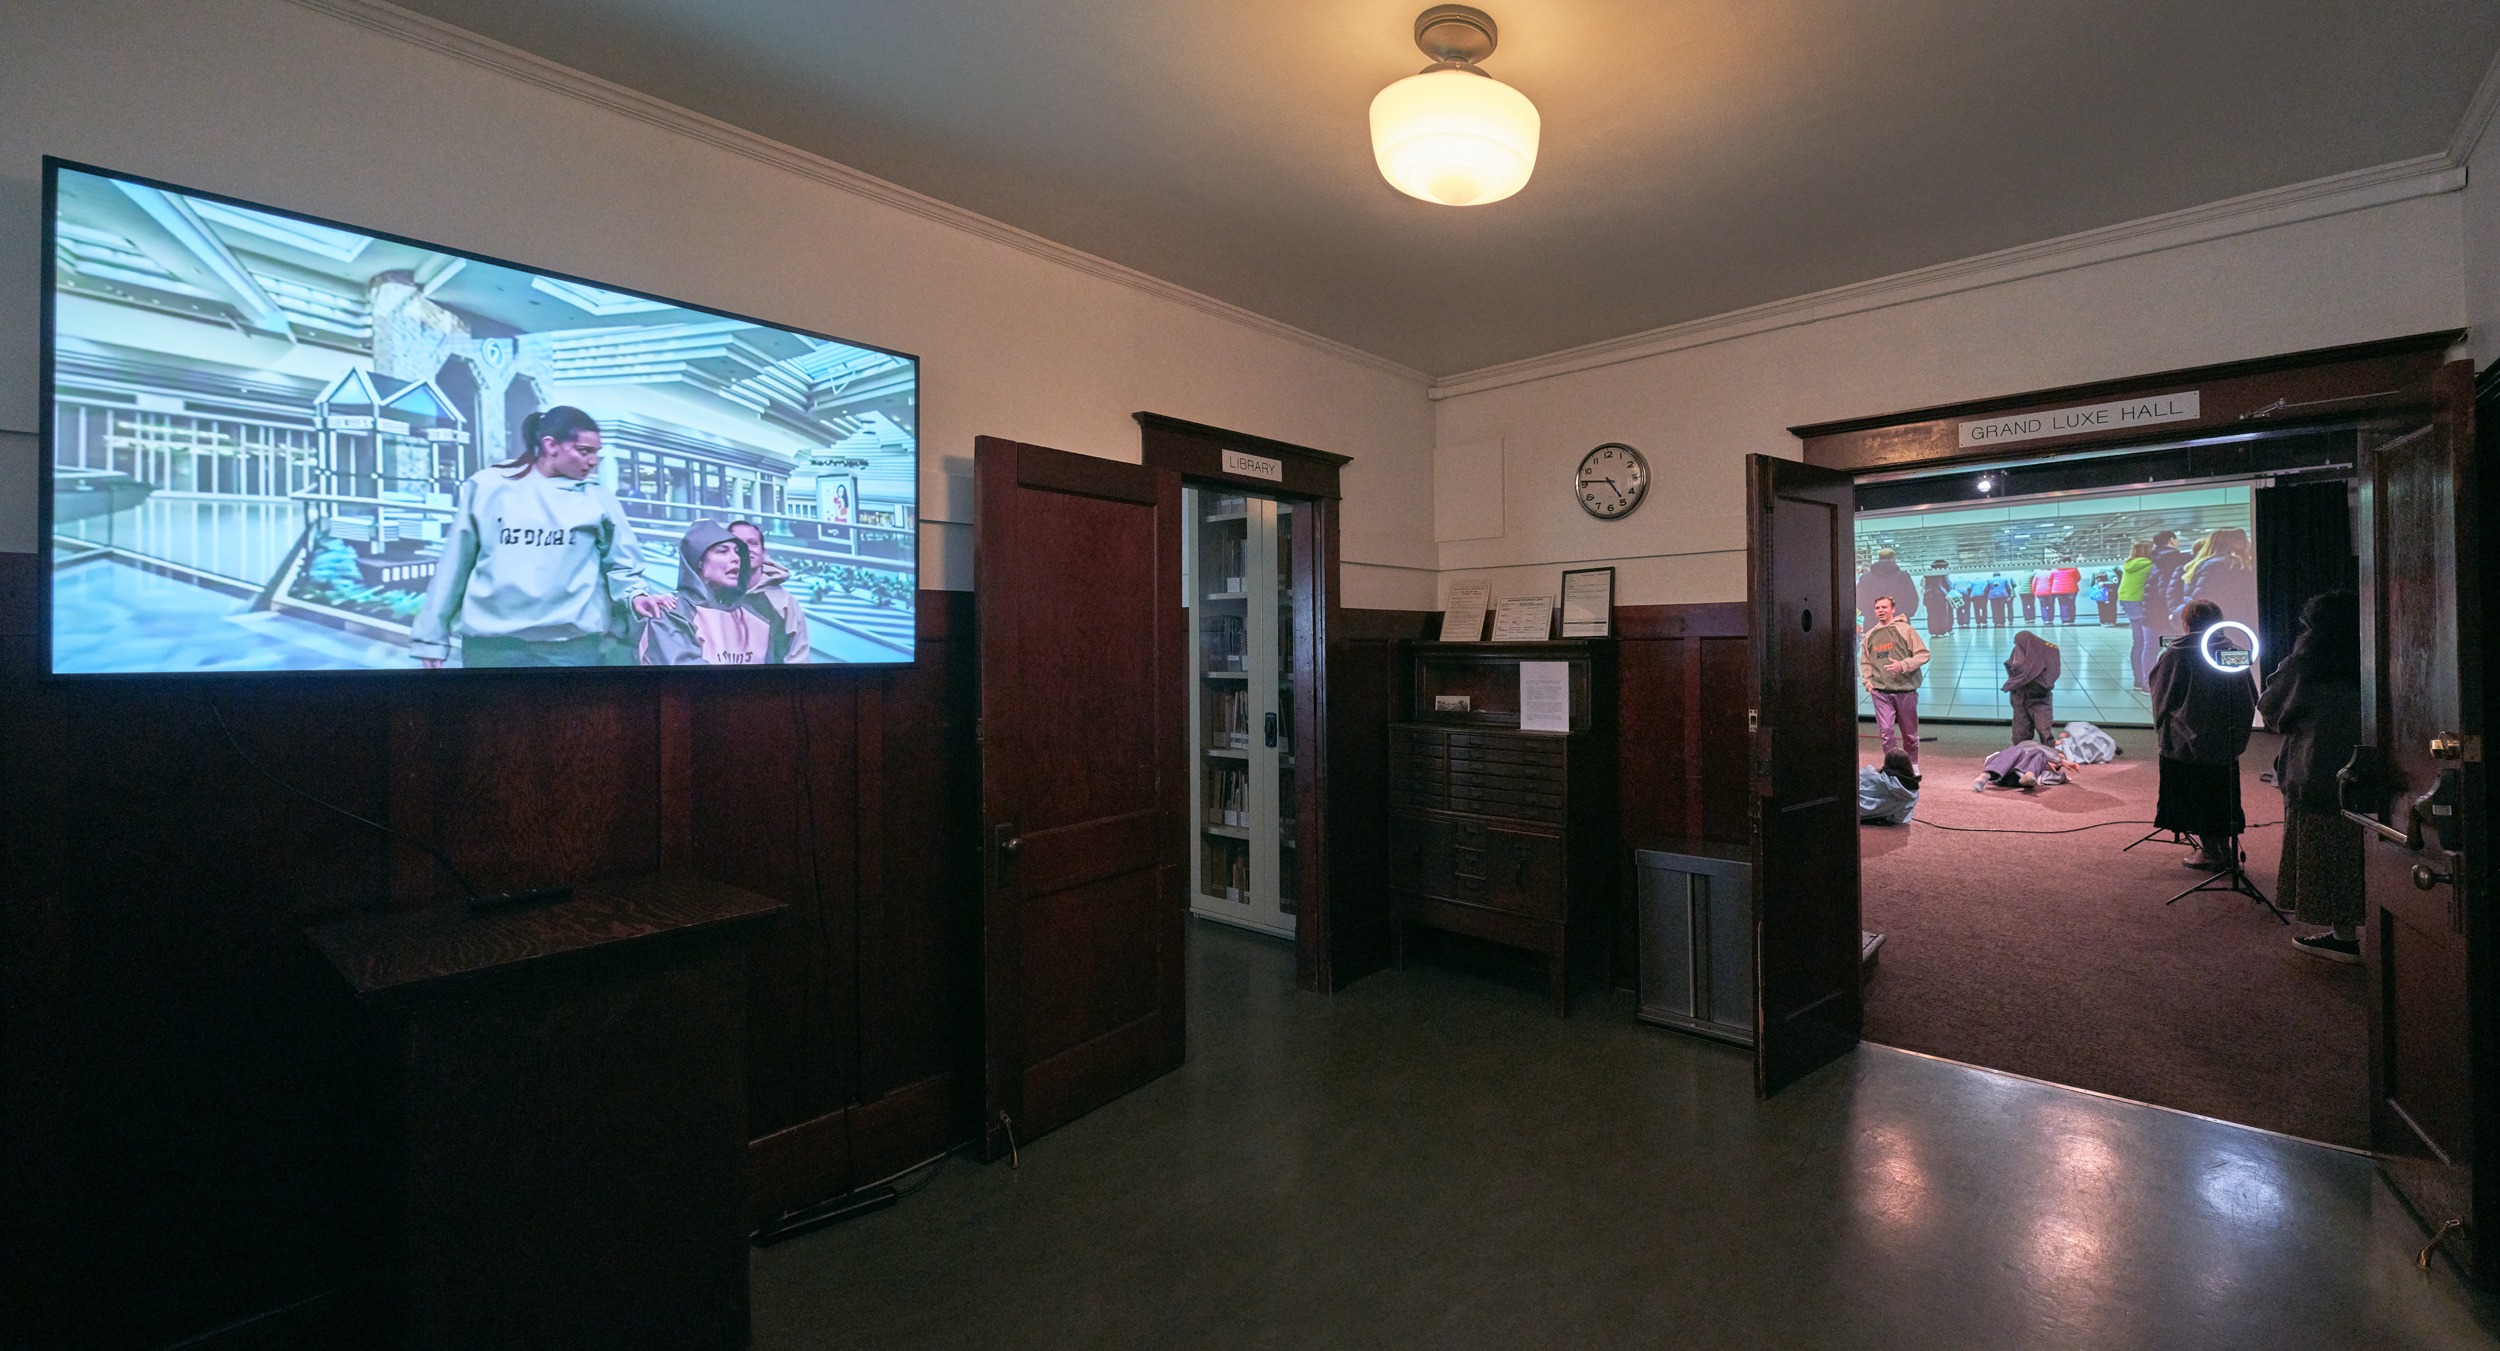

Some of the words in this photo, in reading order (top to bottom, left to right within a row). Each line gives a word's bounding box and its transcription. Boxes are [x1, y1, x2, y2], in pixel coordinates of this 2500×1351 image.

[1971, 419, 2041, 440] GRAND
[2053, 409, 2109, 429] LUXE
[2121, 401, 2183, 421] HALL
[1604, 451, 1613, 459] 12
[1229, 455, 1276, 475] LIBRARY
[1593, 457, 1599, 465] 11
[1626, 460, 1634, 468] 2
[1584, 467, 1592, 475] 10
[1581, 480, 1588, 489] 9
[1628, 487, 1635, 495] 4
[1586, 493, 1594, 501] 8
[1595, 502, 1601, 510] 7
[1619, 498, 1627, 506] 5
[1607, 504, 1614, 512] 6
